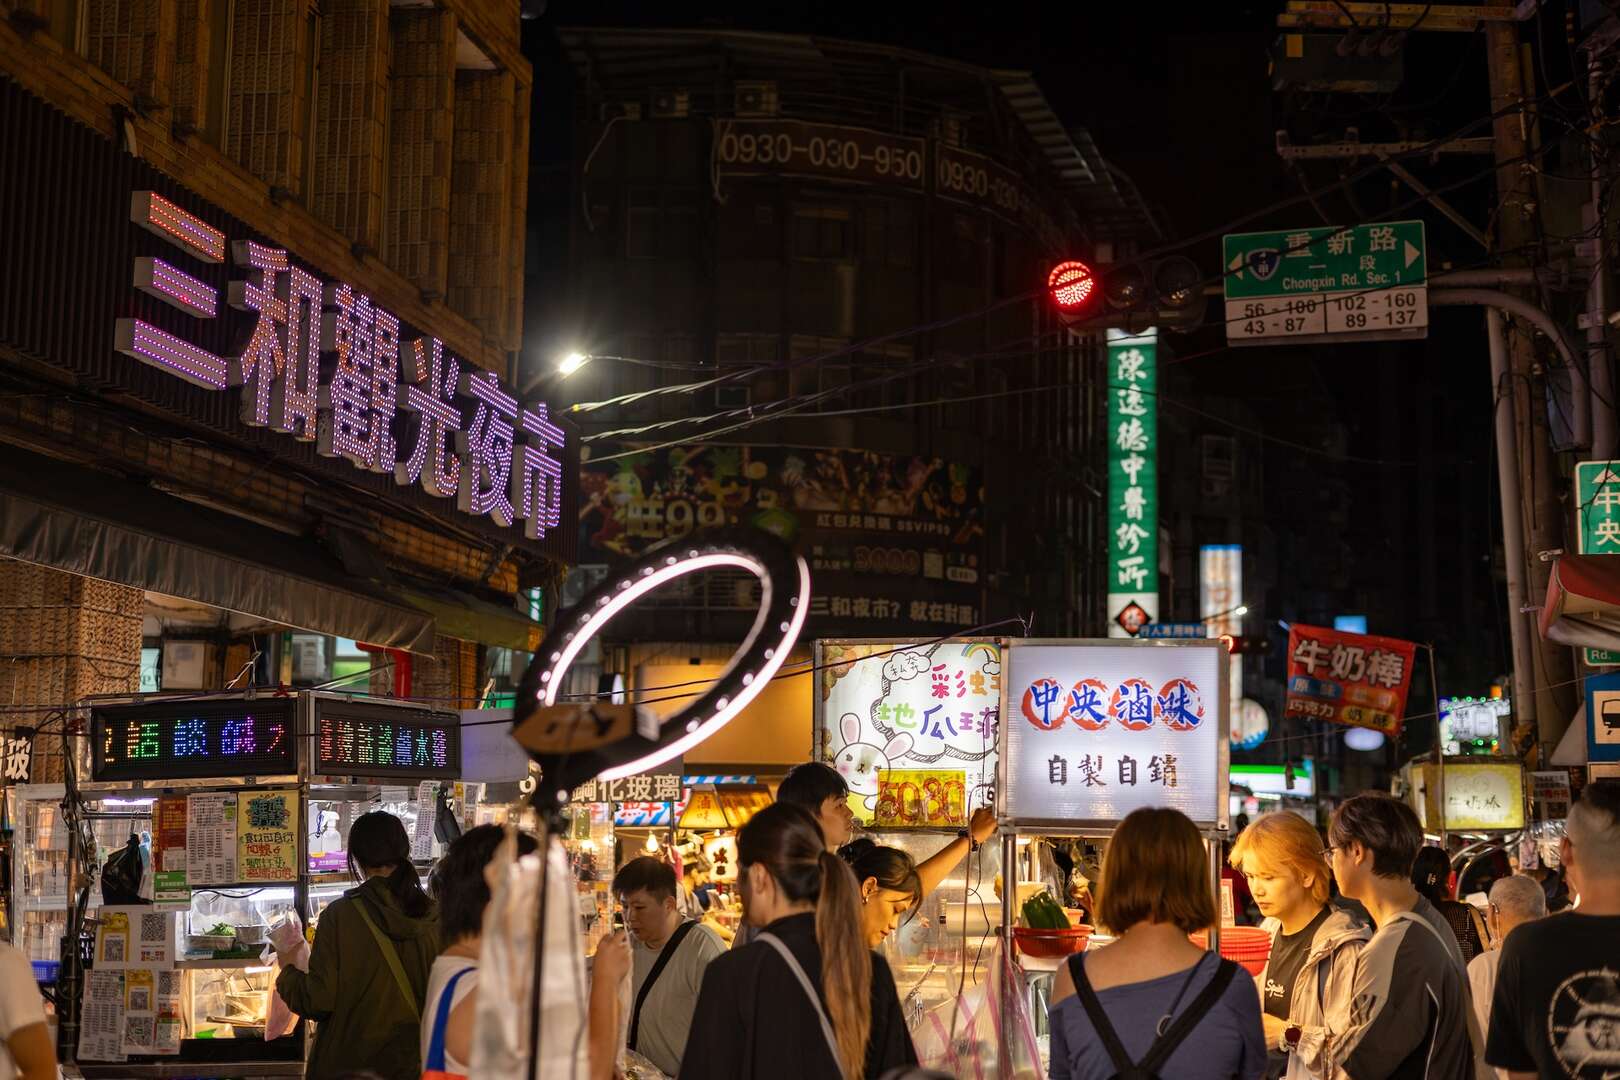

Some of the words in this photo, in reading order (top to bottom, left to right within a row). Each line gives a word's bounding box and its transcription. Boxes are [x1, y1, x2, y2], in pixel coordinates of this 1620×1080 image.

[720, 133, 922, 179] 0930-030-950
[1285, 227, 1398, 258] 重新路
[1308, 255, 1376, 270] 一段
[1282, 274, 1336, 290] Chongxin
[1341, 272, 1361, 286] Rd.
[1366, 271, 1391, 284] Sec.
[1394, 270, 1401, 283] 1
[1244, 303, 1265, 318] 56
[1286, 300, 1317, 315] 100
[1336, 296, 1366, 312] 102
[1384, 293, 1417, 308] 160
[1244, 320, 1265, 335] 43
[1285, 317, 1306, 332] 87
[1345, 314, 1367, 328] 89
[1385, 310, 1417, 325] 137
[116, 190, 566, 539] 三和觀光夜市
[1592, 486, 1620, 554] 中央
[1293, 639, 1404, 688] 牛奶棒
[1591, 649, 1612, 661] Rd.
[1030, 681, 1201, 726] 中央滷味
[1288, 698, 1335, 718] 巧克力
[879, 702, 1000, 740] 地瓜球
[571, 773, 681, 802] 鋼化玻璃
